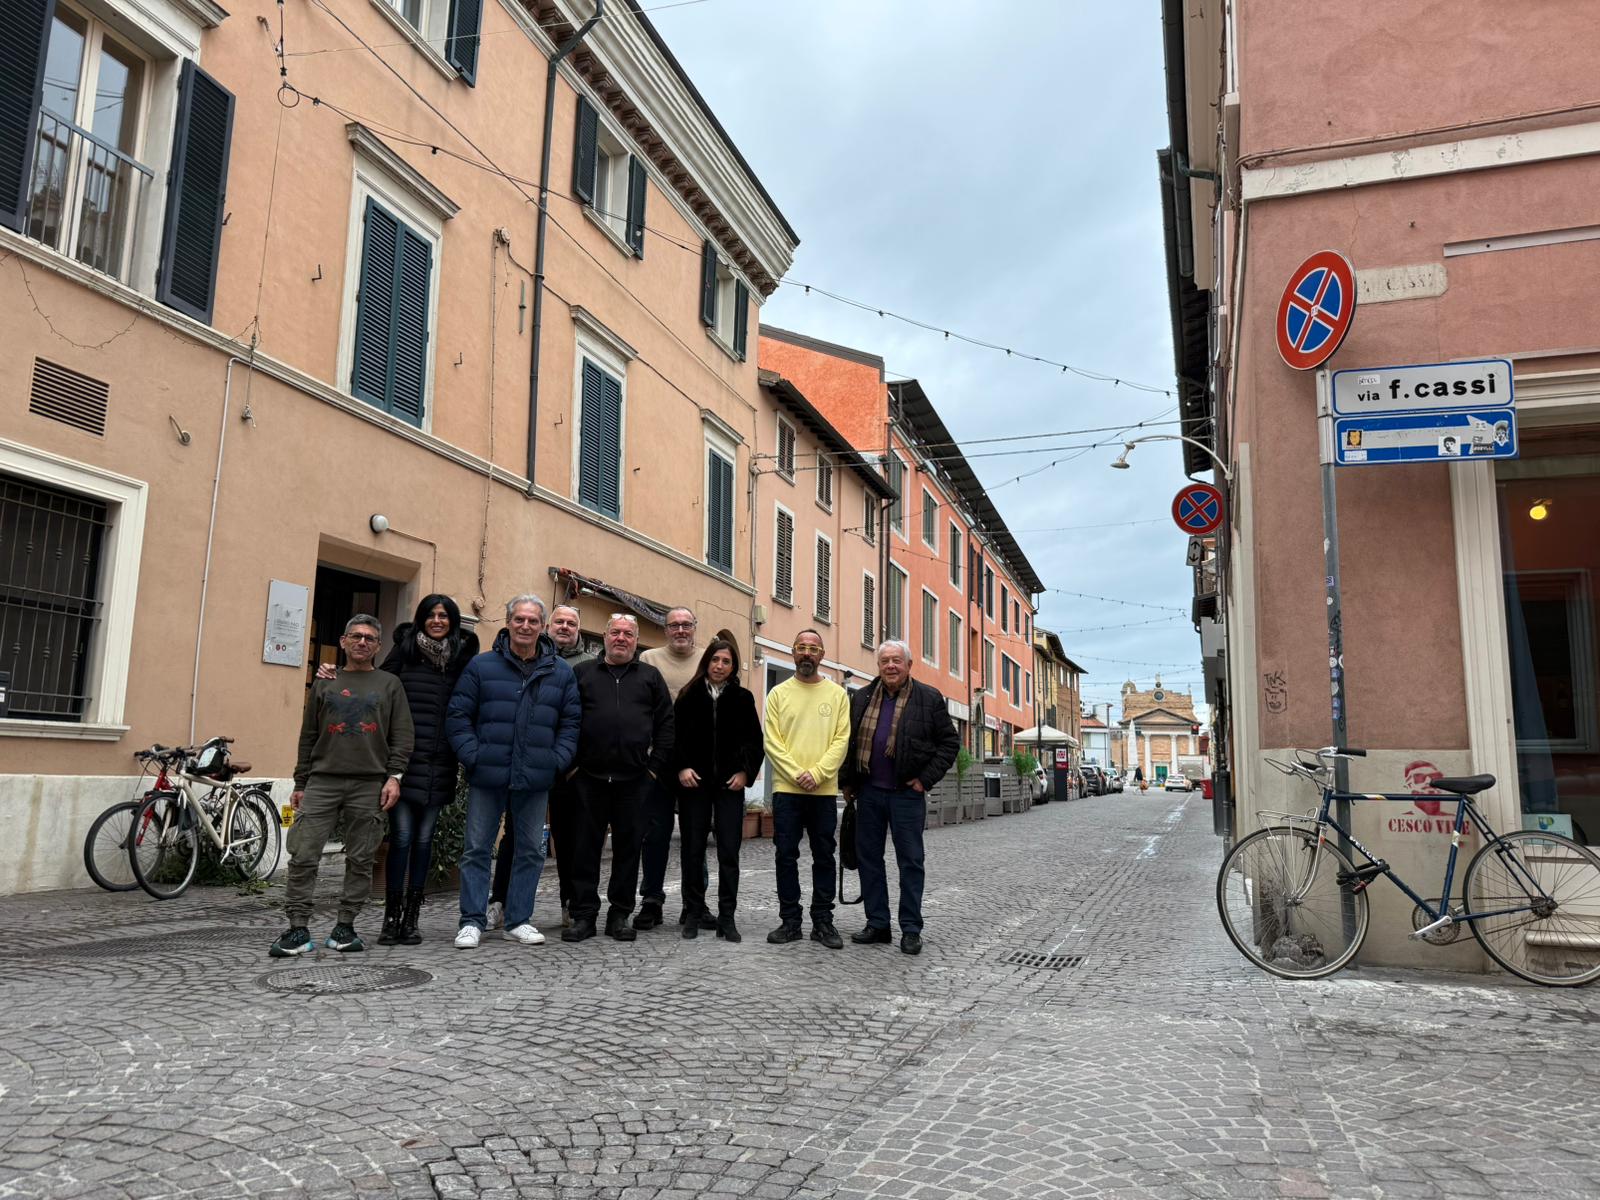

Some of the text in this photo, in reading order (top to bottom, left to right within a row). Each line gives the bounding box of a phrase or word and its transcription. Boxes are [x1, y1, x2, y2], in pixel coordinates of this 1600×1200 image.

[1357, 390, 1380, 402] via
[1388, 818, 1471, 835] CESCO VIE
